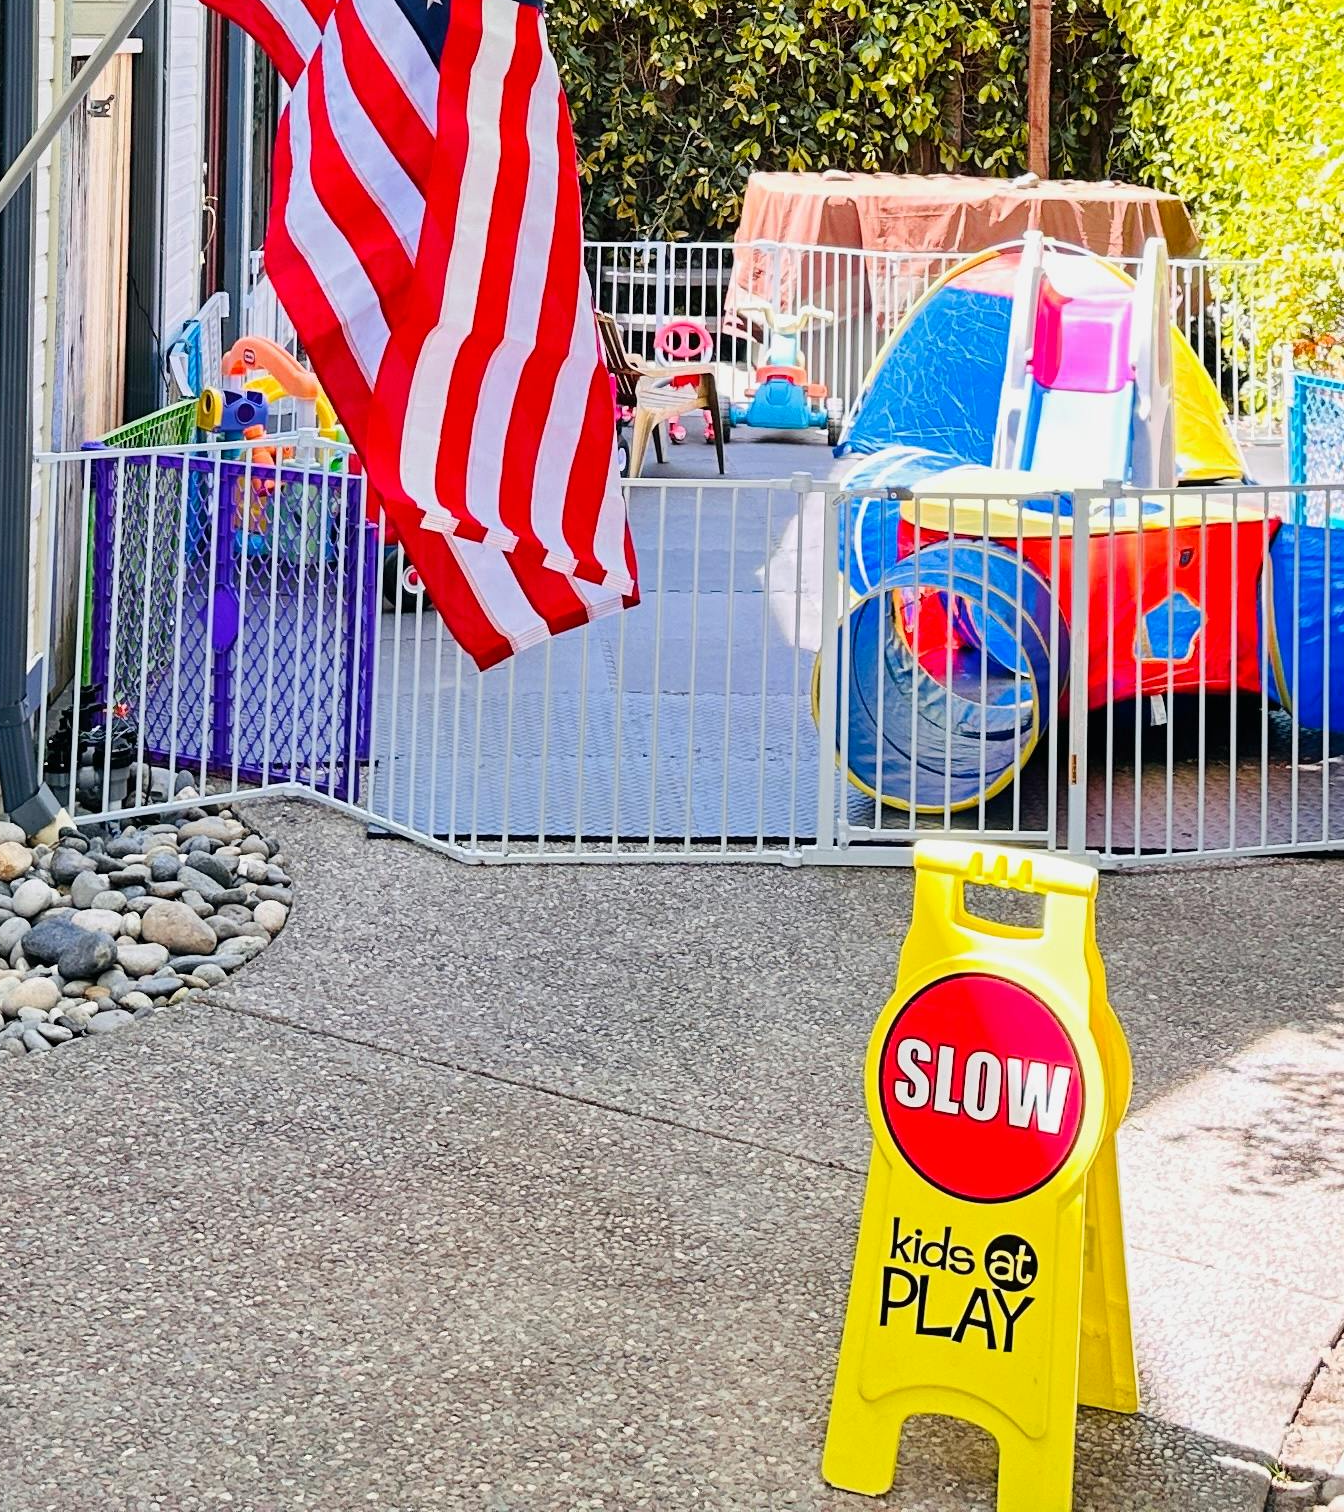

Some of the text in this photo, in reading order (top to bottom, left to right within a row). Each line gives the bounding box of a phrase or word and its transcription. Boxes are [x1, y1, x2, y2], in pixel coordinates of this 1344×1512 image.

[894, 1038, 1072, 1136] SLOW
[889, 1217, 1035, 1285] kids at
[879, 1266, 1035, 1353] PLAY
